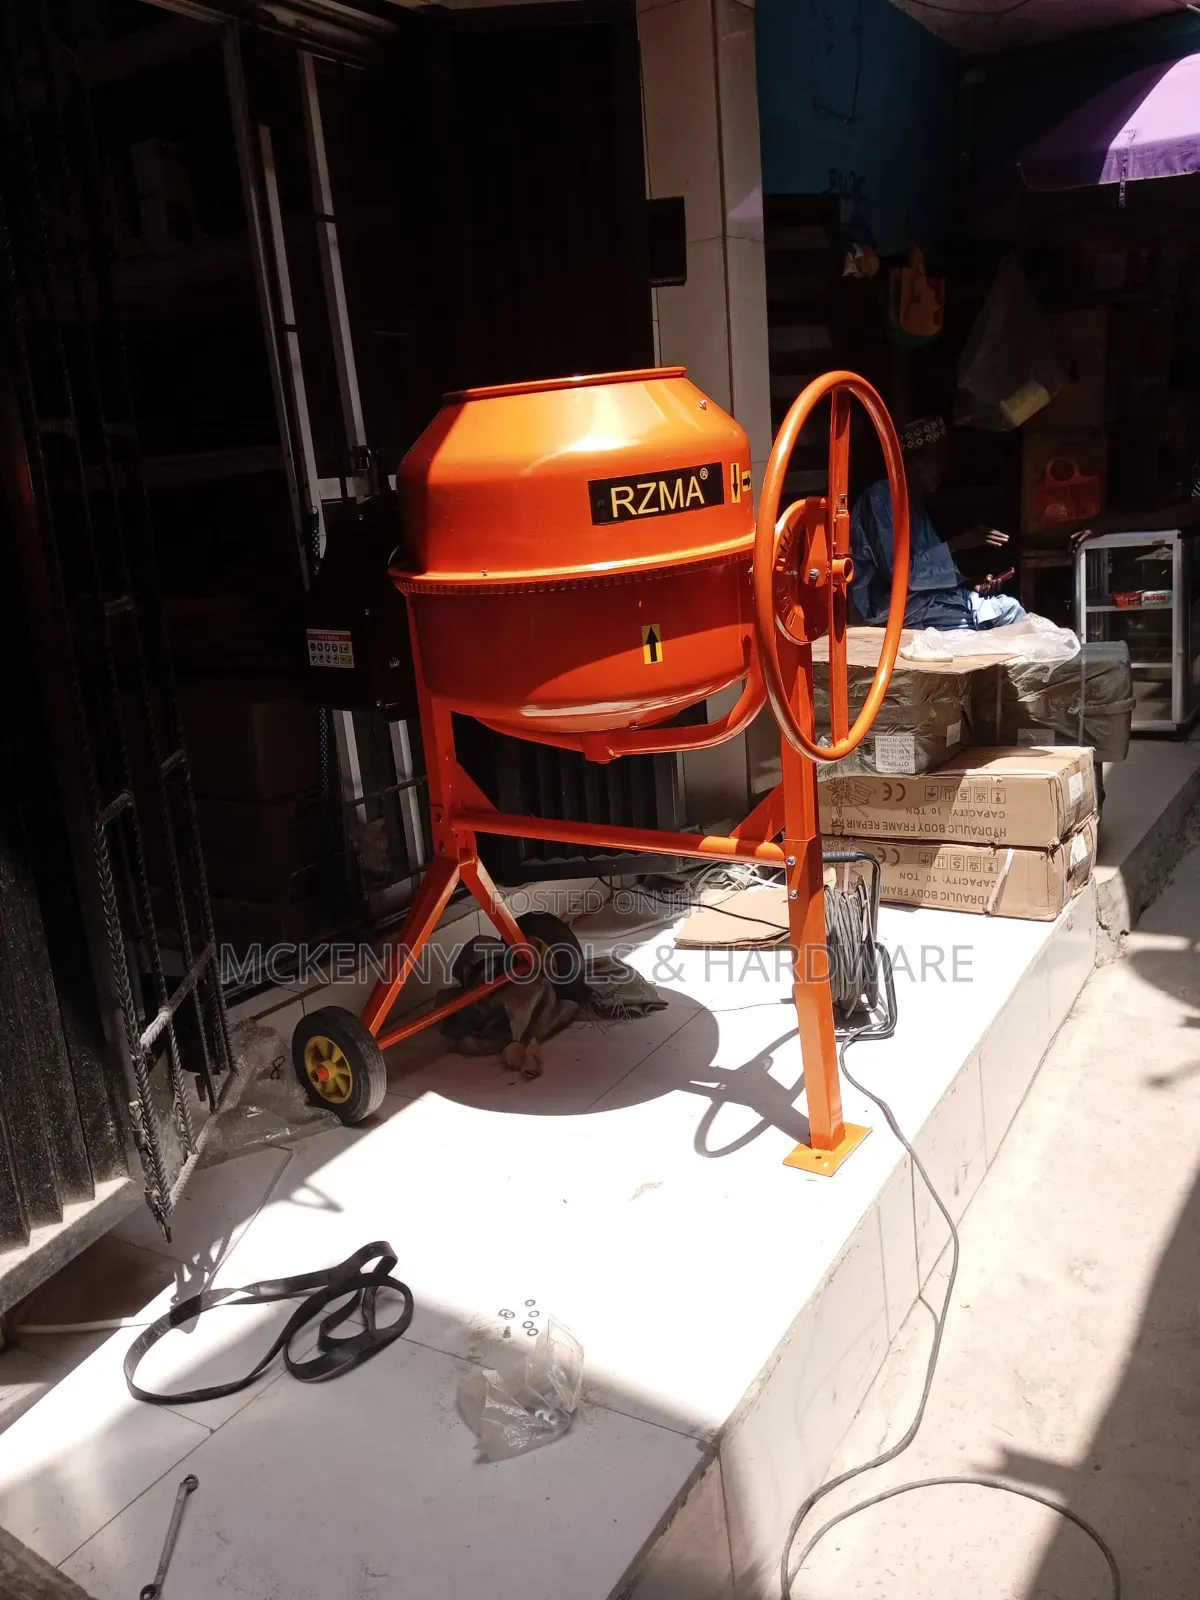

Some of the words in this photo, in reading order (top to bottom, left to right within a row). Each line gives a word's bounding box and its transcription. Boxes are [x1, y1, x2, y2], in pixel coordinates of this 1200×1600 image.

[905, 806, 926, 816] TON
[931, 807, 942, 815] 10
[949, 808, 1006, 819] CAPACITY:
[846, 819, 880, 831] REPAIR
[882, 821, 916, 832] FRAME
[917, 821, 946, 834] BODY
[948, 824, 1007, 838] HYDRAULIC
[899, 872, 920, 881] TON
[926, 875, 937, 883] 10
[911, 887, 938, 900] BODY
